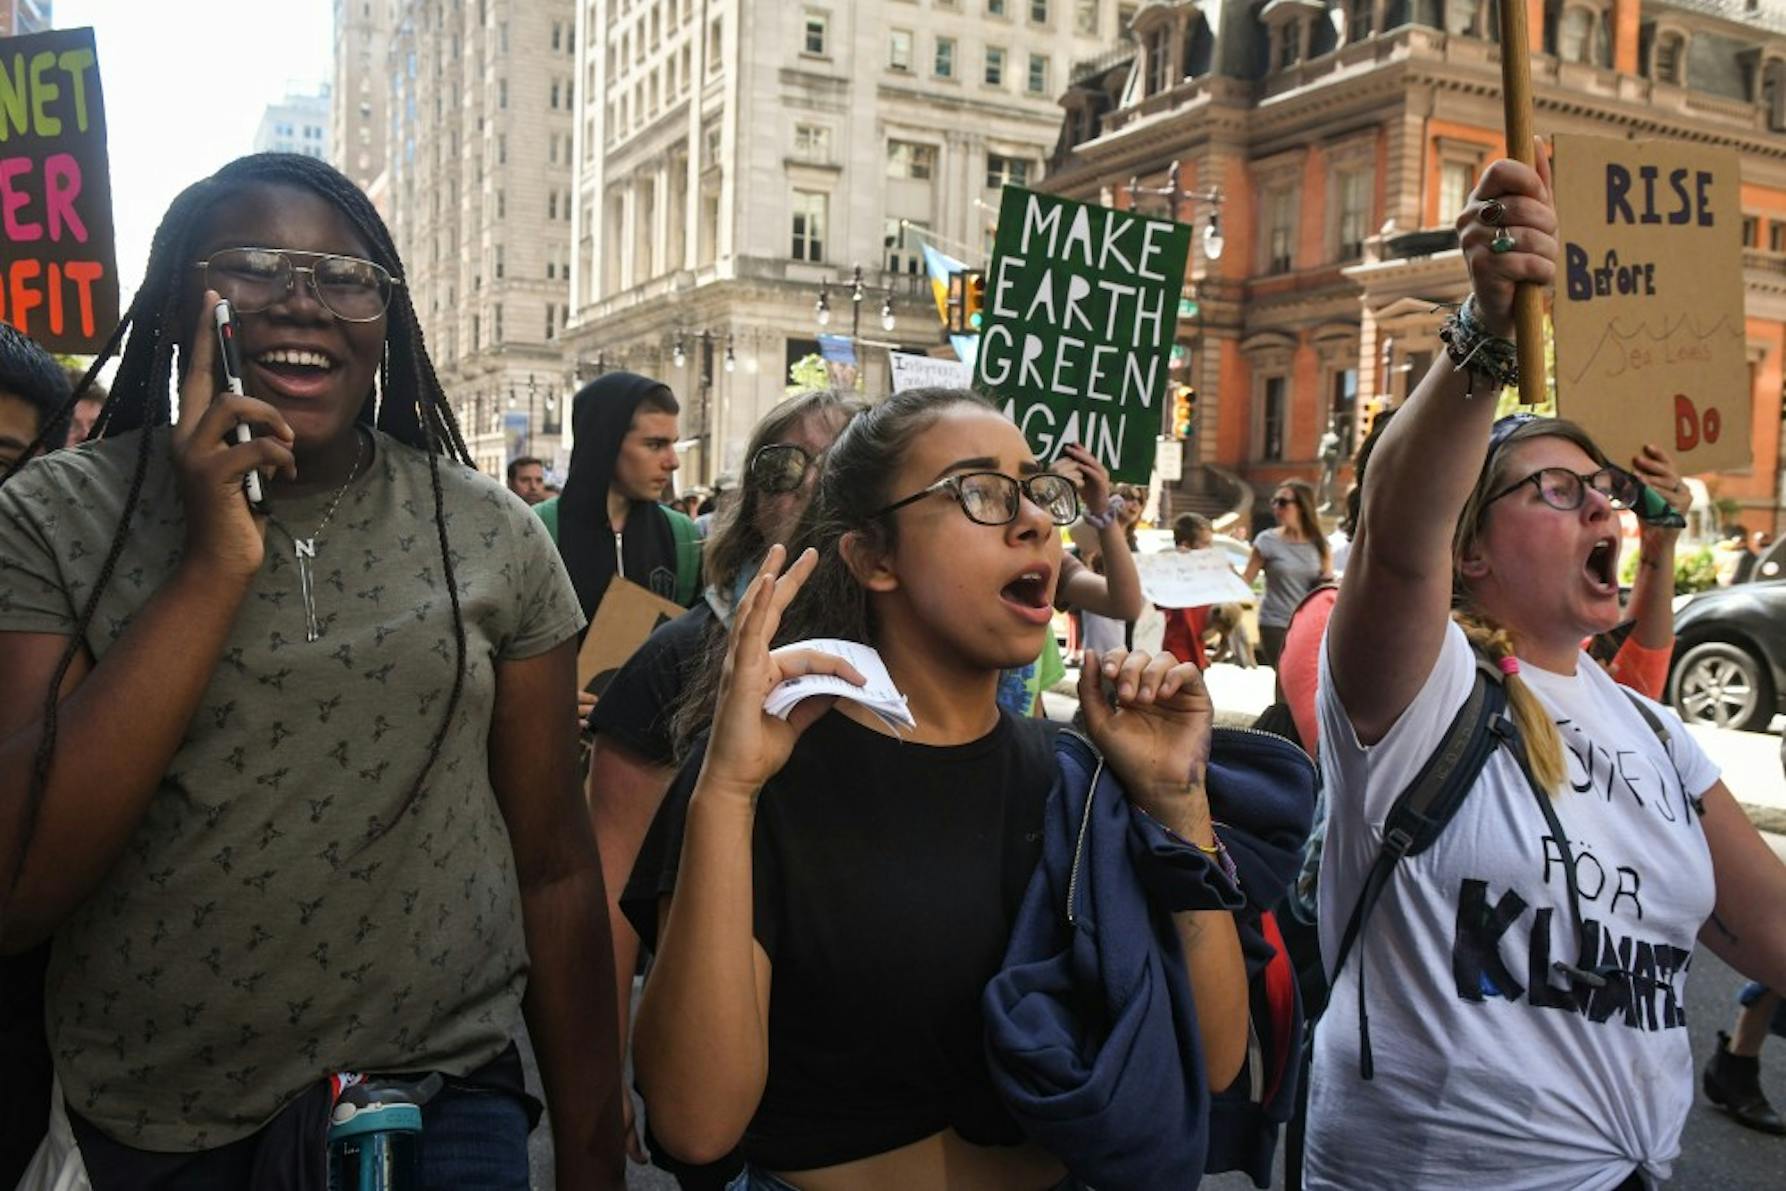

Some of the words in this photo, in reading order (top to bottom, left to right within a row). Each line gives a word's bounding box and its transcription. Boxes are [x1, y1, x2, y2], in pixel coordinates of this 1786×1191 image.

[0, 153, 88, 243] ER
[1021, 194, 1174, 281] MAKE
[1606, 163, 1715, 227] RISE
[0, 258, 103, 338] FIT
[993, 255, 1164, 347] EARTH
[980, 324, 1159, 408] GREEN
